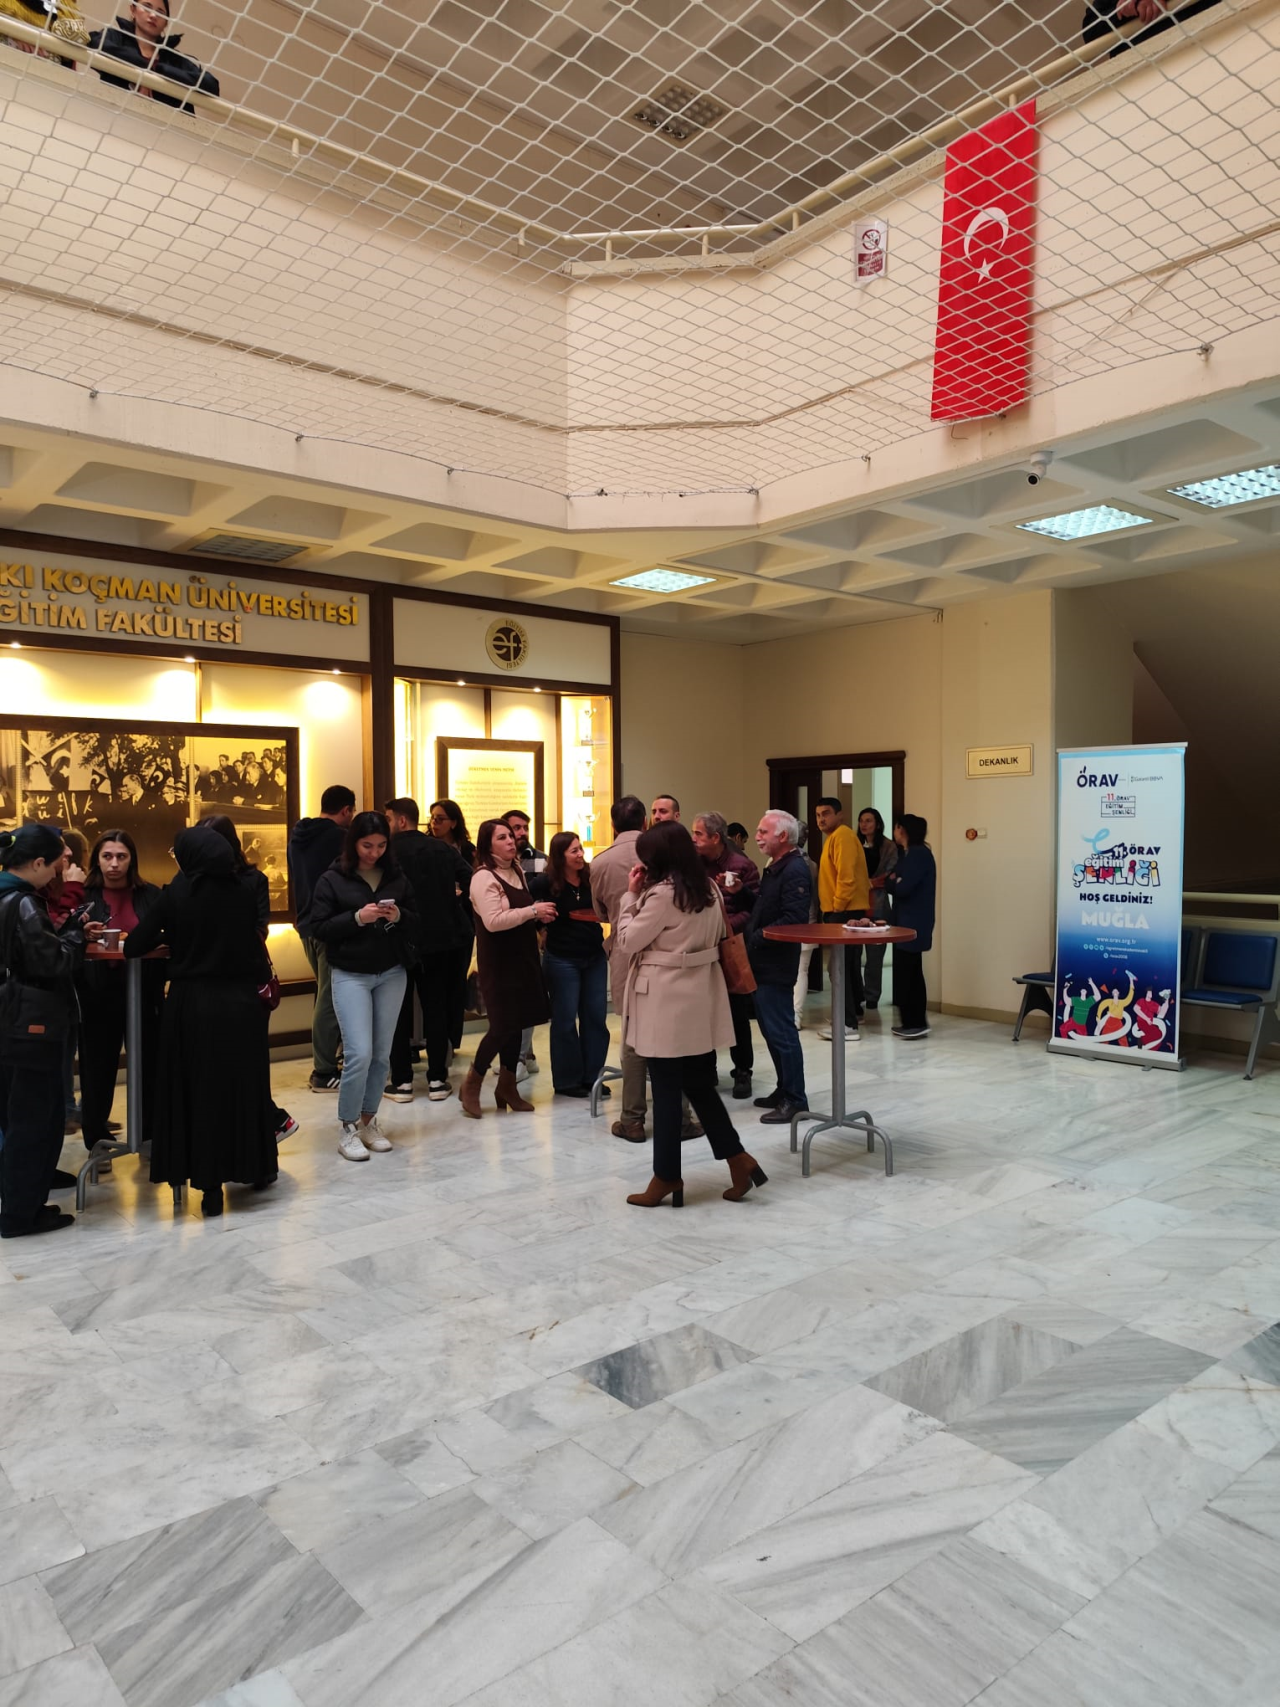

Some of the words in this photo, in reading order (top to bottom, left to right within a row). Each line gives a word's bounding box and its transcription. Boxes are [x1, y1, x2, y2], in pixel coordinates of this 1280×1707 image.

[42, 566, 181, 605] KOÇMAN
[189, 575, 358, 625] ÜNİVERSİTESİ
[96, 606, 242, 644] FAKÜLTESİ
[979, 756, 1019, 767] DEKANLIK
[1077, 765, 1119, 788] ÖRAV
[1129, 843, 1161, 856] ÖRAV
[1084, 853, 1125, 870] eğitim
[1072, 859, 1161, 888] ŞENLİĞİ
[1079, 892, 1100, 905] HOŞ
[1102, 891, 1153, 905] GELDİNİZ!
[1081, 905, 1150, 930] MUĞLA
